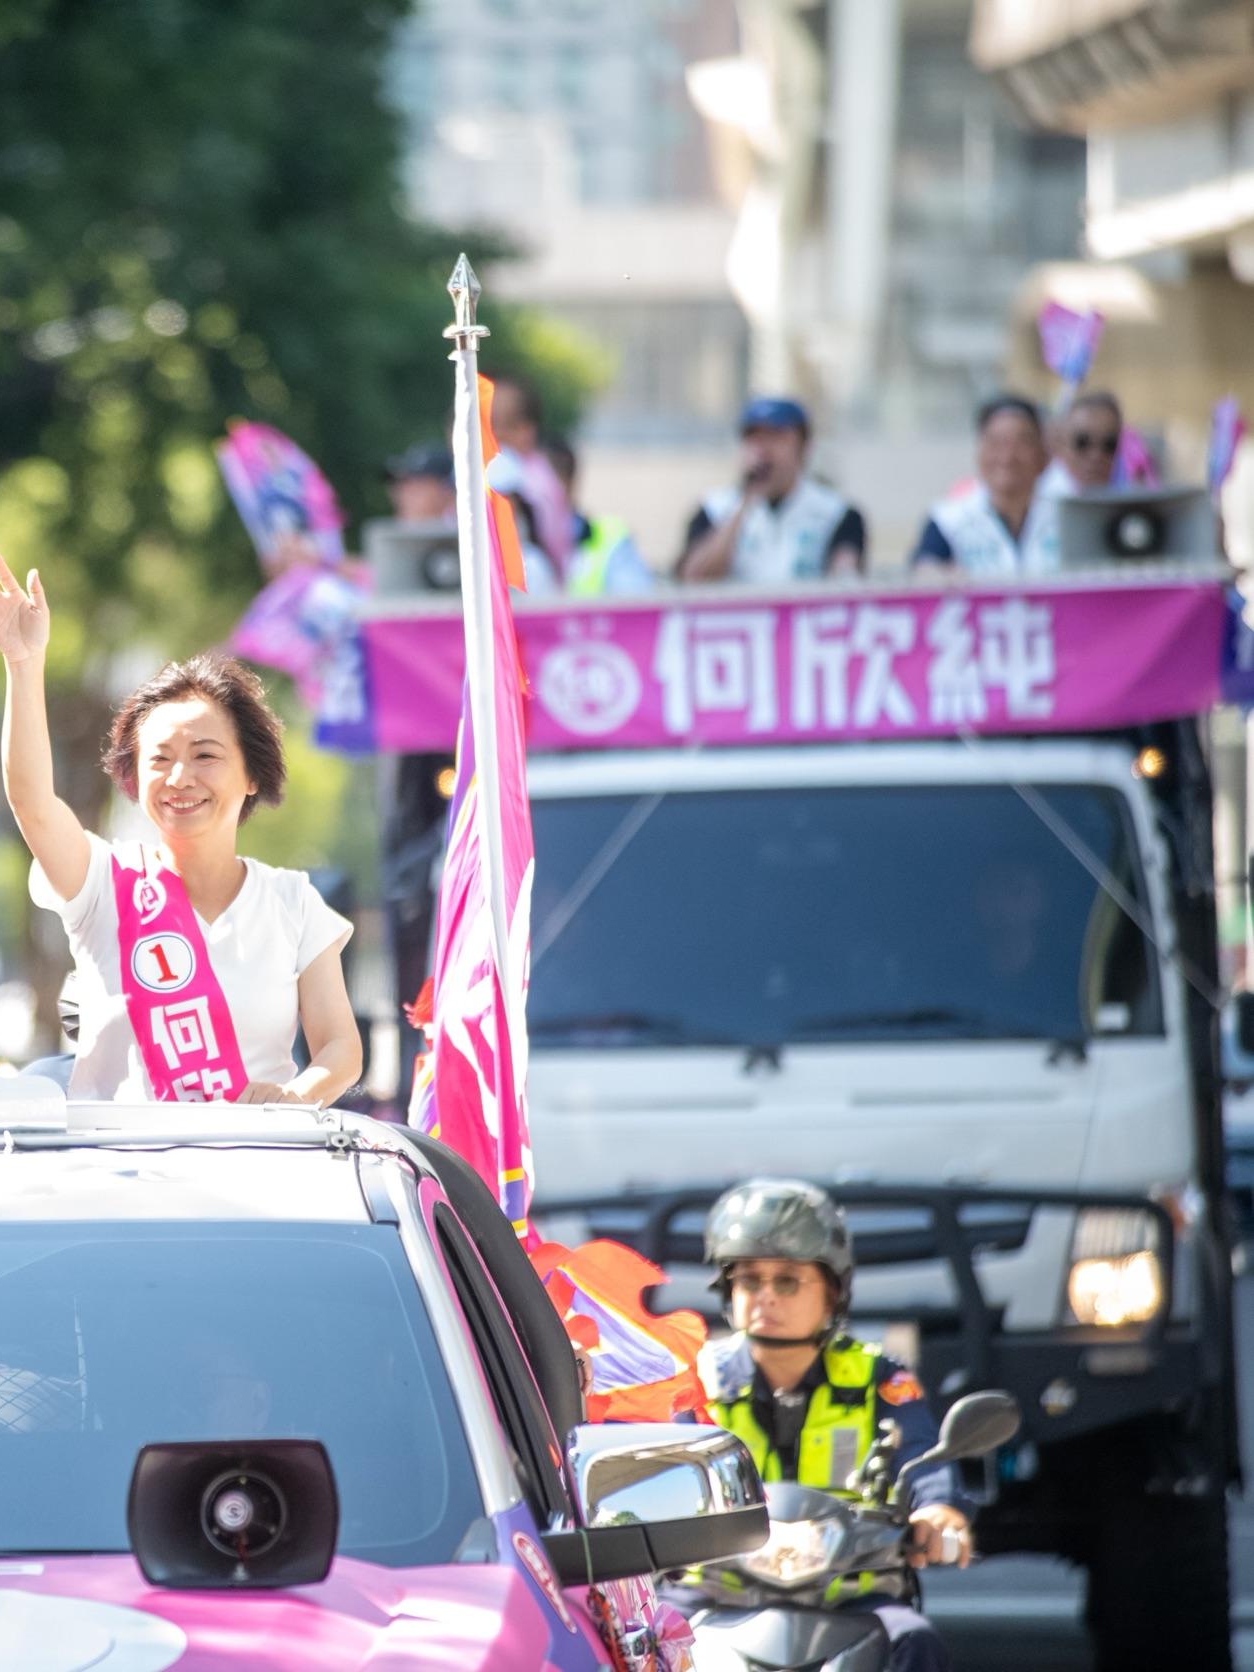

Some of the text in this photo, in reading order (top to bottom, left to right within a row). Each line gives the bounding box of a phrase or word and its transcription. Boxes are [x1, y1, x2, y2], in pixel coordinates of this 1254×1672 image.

[654, 600, 1056, 734] 何欣純
[149, 943, 179, 983] 1
